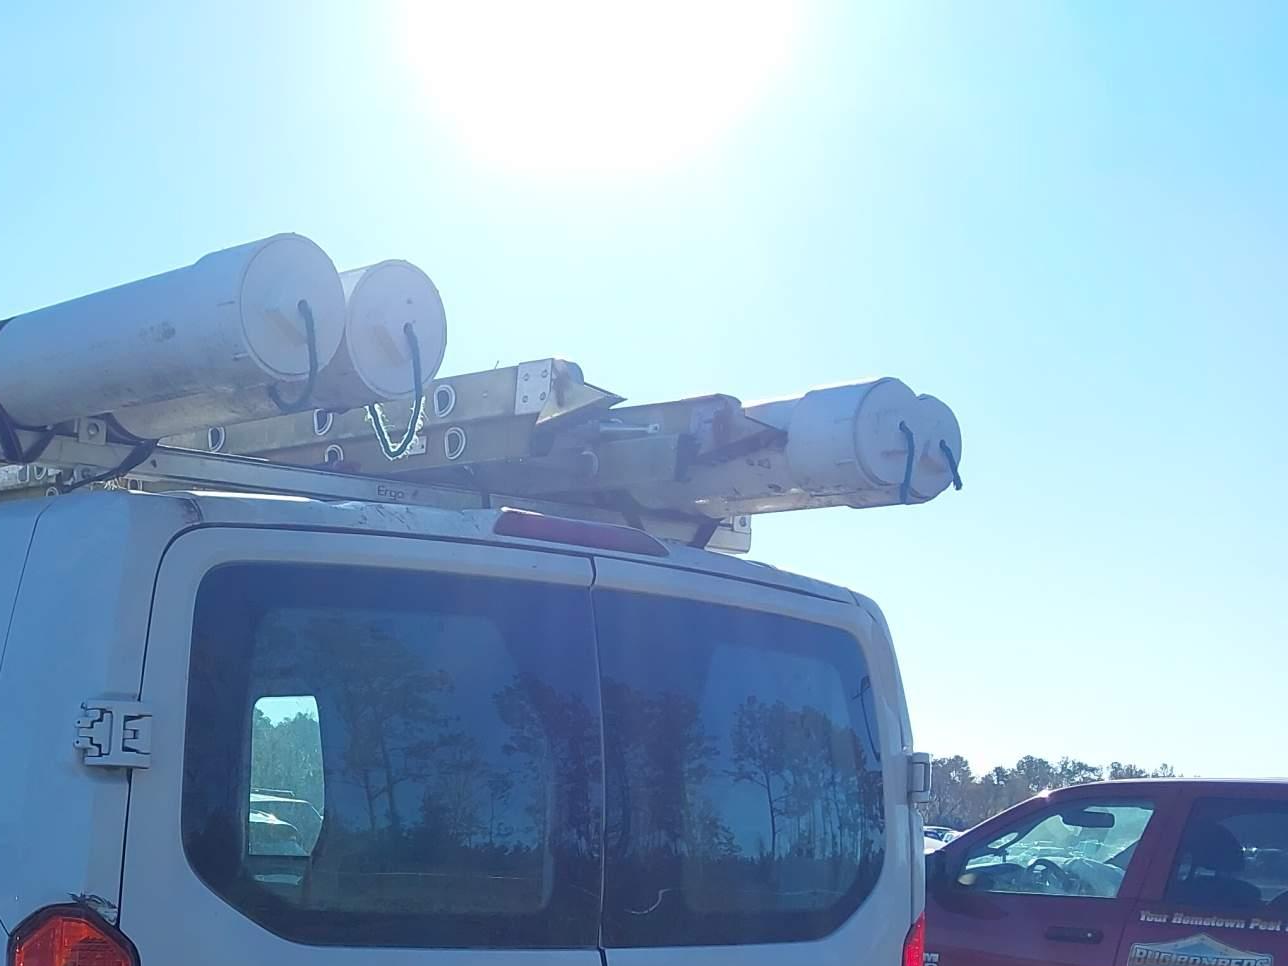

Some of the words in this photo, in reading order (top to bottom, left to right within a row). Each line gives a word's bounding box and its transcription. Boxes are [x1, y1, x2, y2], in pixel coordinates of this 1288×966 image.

[1140, 911, 1168, 923] Your
[1171, 912, 1245, 929] Hometown
[1134, 948, 1171, 966] BUG
